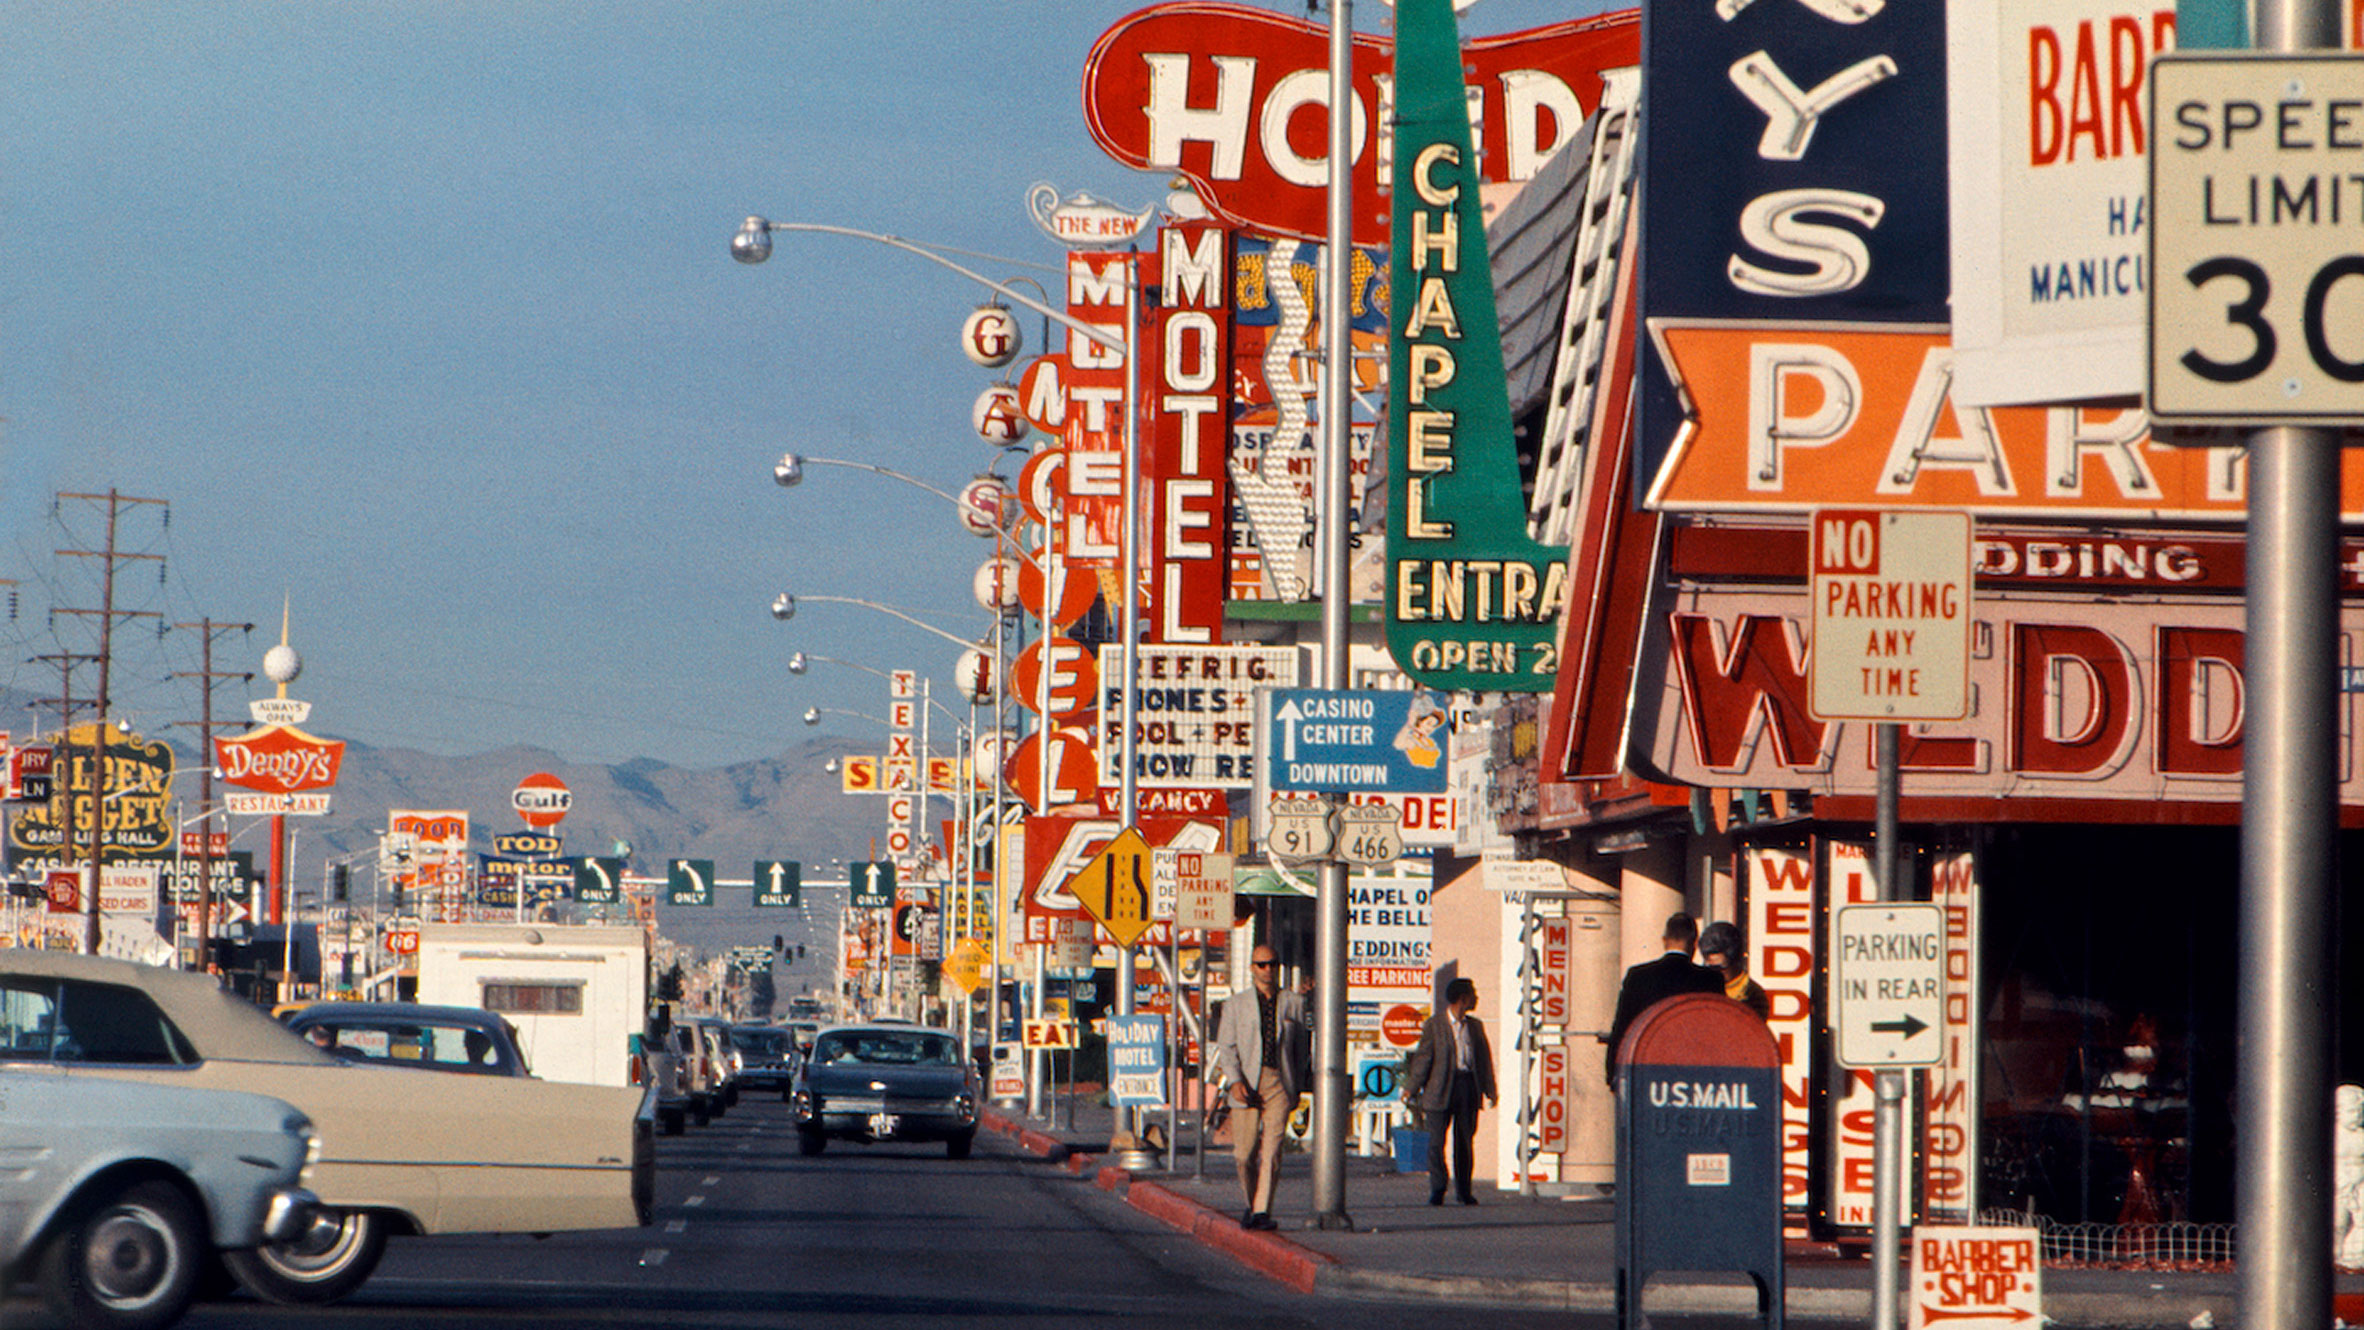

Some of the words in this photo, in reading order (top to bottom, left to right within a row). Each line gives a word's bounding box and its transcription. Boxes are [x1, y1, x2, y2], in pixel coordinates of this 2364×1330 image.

[1716, 0, 1898, 297] YS
[1057, 216, 1091, 235] THE
[1098, 216, 1138, 236] NEW
[1404, 143, 1462, 539] CHAPEL
[1068, 260, 1127, 558] MOTEL
[1160, 228, 1224, 642] MOTEL
[1823, 520, 1873, 568] NO
[1827, 581, 1957, 620] PARKING
[1867, 630, 1913, 657] ANY
[1412, 640, 1516, 674] OPEN
[1137, 655, 1275, 680] EFRIG.
[1861, 668, 1921, 697] TIME
[258, 703, 302, 712] ALWAYS
[1302, 699, 1374, 719] CASINO
[266, 713, 294, 723] OPEN
[1302, 725, 1374, 745] CENTER
[222, 743, 332, 790] Denny's
[891, 673, 912, 850] TEXACO
[1289, 764, 1388, 784] DOWNTOWN
[514, 790, 572, 808] Gulf
[1279, 803, 1320, 813] NEVADA
[1350, 808, 1392, 819] NEVADA
[398, 821, 462, 837] FOOD
[500, 836, 560, 852] TOD
[1285, 831, 1312, 854] 91
[1351, 835, 1389, 860] 466
[487, 860, 571, 875] motor
[1180, 856, 1201, 876] NO
[582, 889, 613, 901] ONLY
[1181, 879, 1230, 893] PARKING
[675, 893, 706, 905] ONLY
[761, 894, 792, 906] ONLY
[856, 894, 888, 906] ONLY
[1415, 888, 1432, 905] O
[1377, 909, 1432, 926] BELL
[1843, 934, 1938, 963] PARKING
[1371, 969, 1432, 985] PARKING
[1548, 925, 1567, 1018] MENS
[1845, 980, 1867, 999] IN
[1878, 979, 1938, 999] REAR
[1027, 1024, 1076, 1046] EAT
[1114, 1047, 1157, 1066] MOTEL
[1544, 1052, 1565, 1145] SHOP
[1921, 1239, 2036, 1273] BARBER
[1939, 1273, 2018, 1305] SHOP
